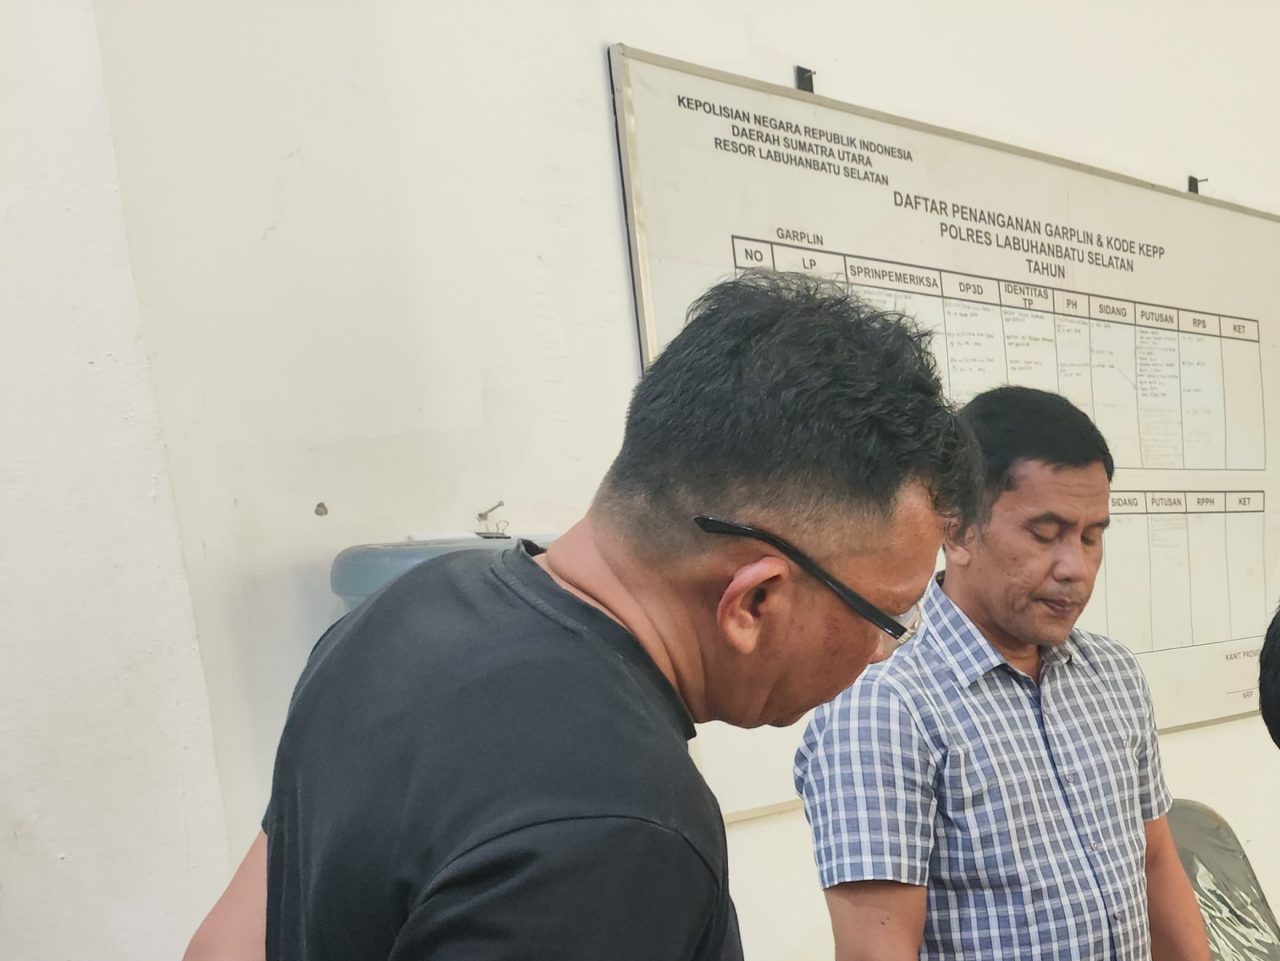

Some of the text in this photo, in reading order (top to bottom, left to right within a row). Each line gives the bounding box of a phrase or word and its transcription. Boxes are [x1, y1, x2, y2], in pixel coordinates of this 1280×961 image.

[677, 95, 913, 162] KEPOLISIAN NEGARA REPUBLIK INDONESIA
[732, 124, 873, 167] DAERAH SUMATRA UTARA
[714, 137, 889, 186] RESOR LABUHANBATU SELATAN
[893, 190, 1165, 260] DAFTAR PENANGANAN GARPLIN & KODE KEPP
[776, 227, 824, 246] GARPLIN
[744, 248, 763, 262] NO
[940, 222, 1134, 273] POLRES LABUHANBATU SELATAN
[802, 257, 817, 270] LP
[1026, 259, 1066, 279] TAHUN
[849, 265, 939, 289] SPRINPEMERIKSA
[959, 281, 983, 296] DP3D
[1004, 283, 1048, 300] IDENTITAS
[1022, 297, 1034, 309] TP
[1066, 299, 1078, 310] PH
[1098, 303, 1127, 318] SIDANG
[1140, 310, 1174, 324] PUTUSAN
[1192, 318, 1206, 328] RPS
[1233, 324, 1246, 334] KET
[1111, 498, 1138, 507] SIDANG
[1151, 497, 1182, 507] PUTUSAN
[1238, 497, 1251, 506] KET
